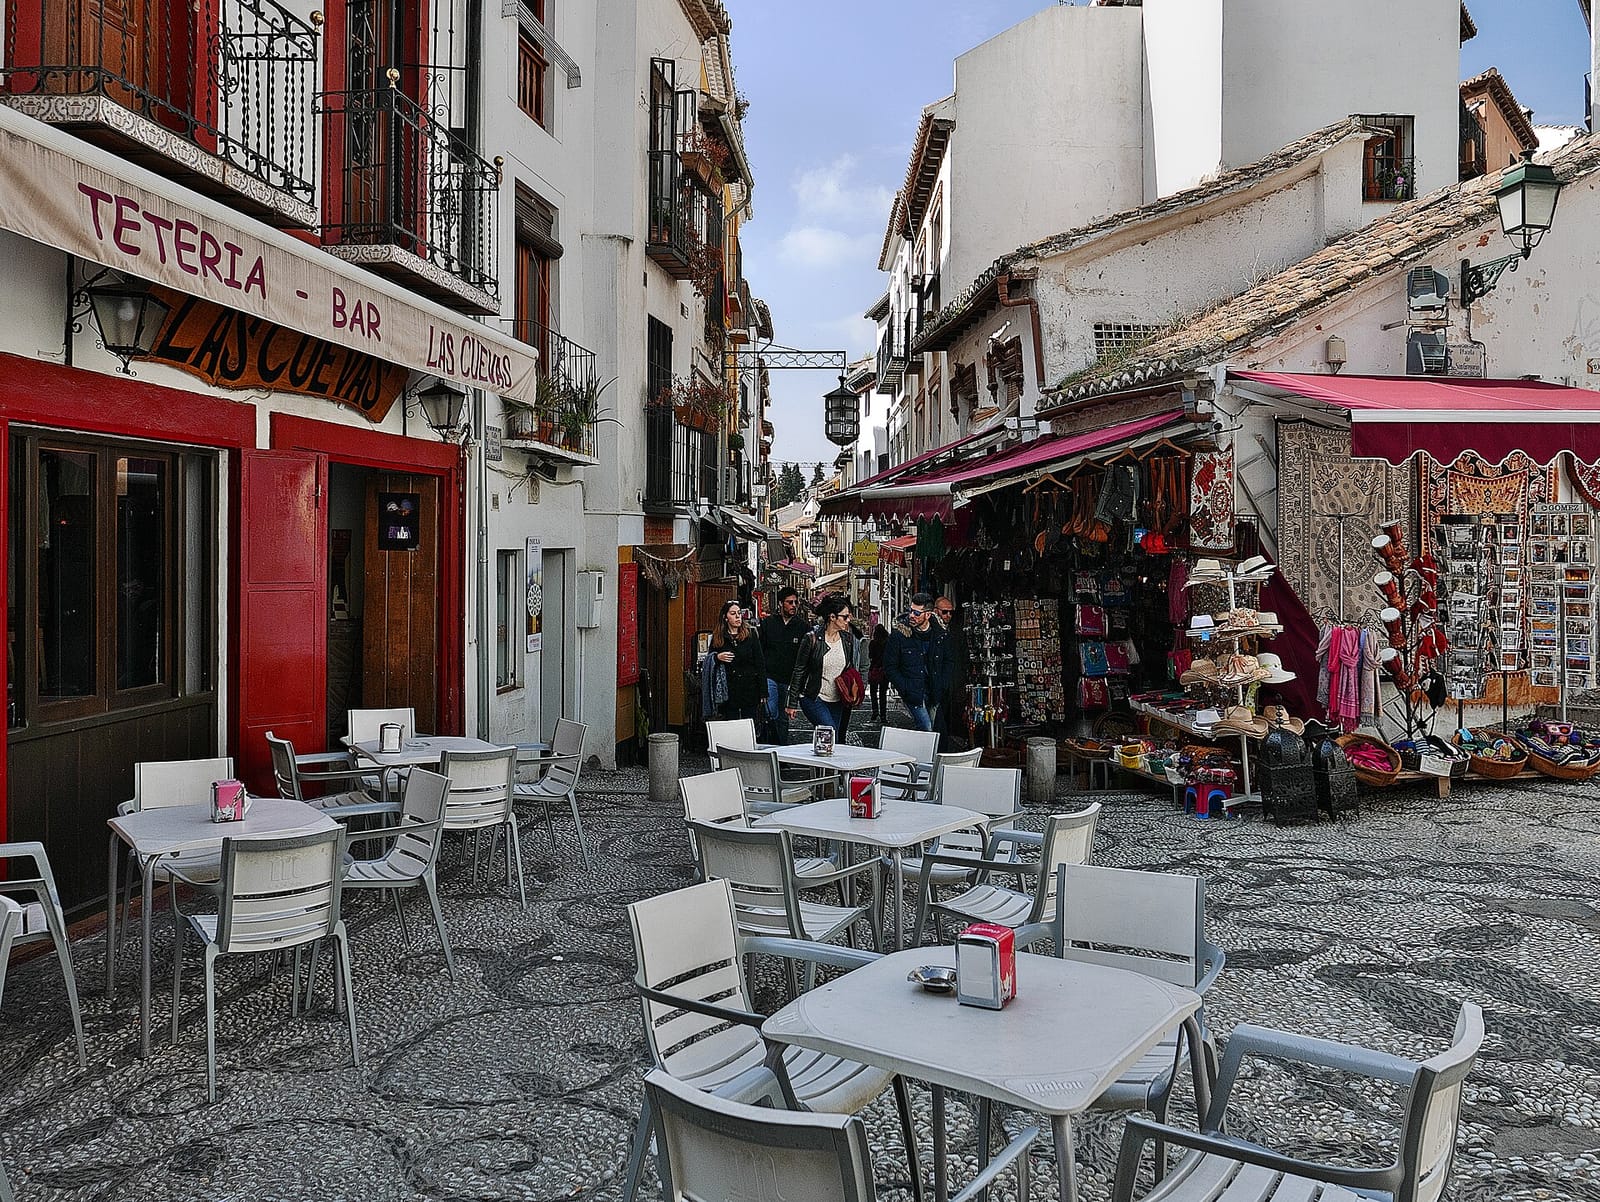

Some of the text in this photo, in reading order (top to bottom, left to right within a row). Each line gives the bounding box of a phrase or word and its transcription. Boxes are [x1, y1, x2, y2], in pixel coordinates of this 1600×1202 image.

[78, 182, 267, 300] TETERIA
[332, 287, 382, 343] BAR
[426, 325, 455, 376] LAS
[460, 335, 512, 389] CUEVAS
[157, 296, 392, 411] LAS CUEVAS
